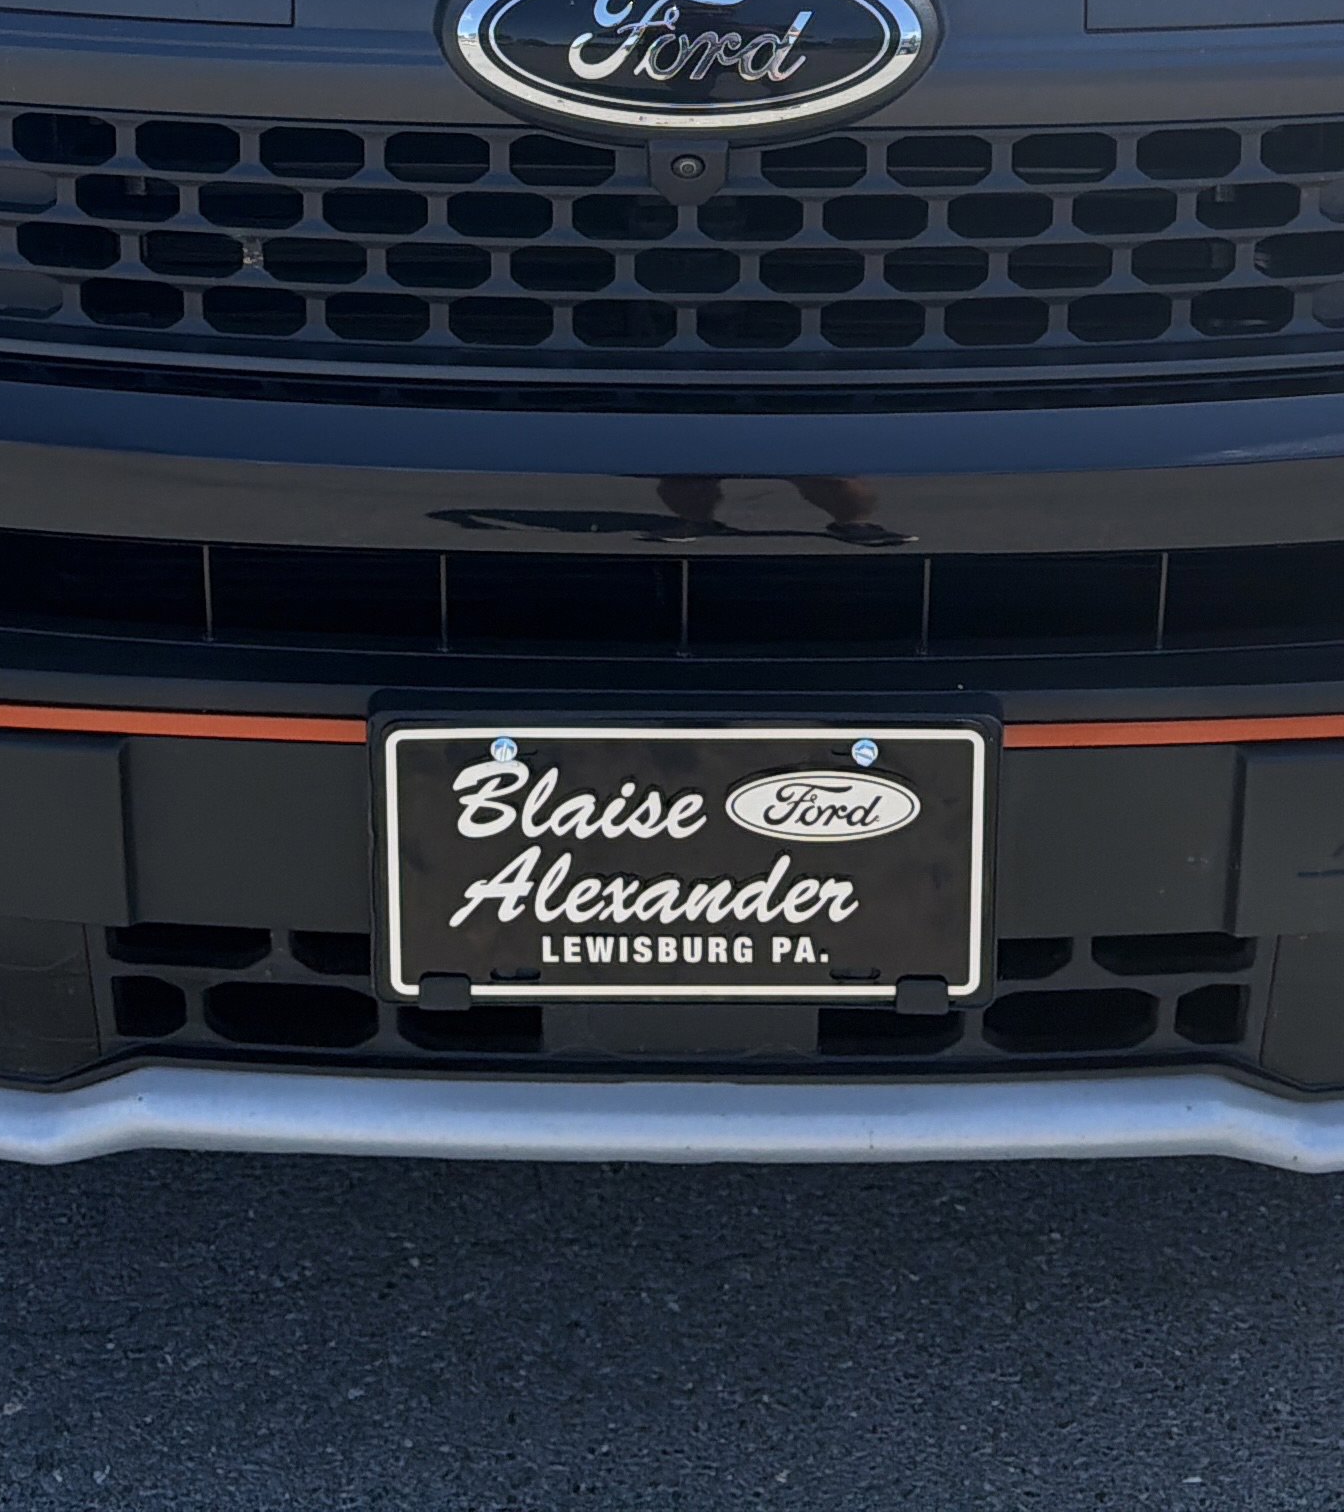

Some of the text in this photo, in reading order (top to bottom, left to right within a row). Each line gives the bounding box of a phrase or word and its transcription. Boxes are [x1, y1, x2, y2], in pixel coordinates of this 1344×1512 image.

[453, 760, 706, 840] Blaise
[763, 782, 882, 827] Ford
[449, 845, 859, 928] Alexander
[542, 935, 829, 964] LEWISBURG PA.
